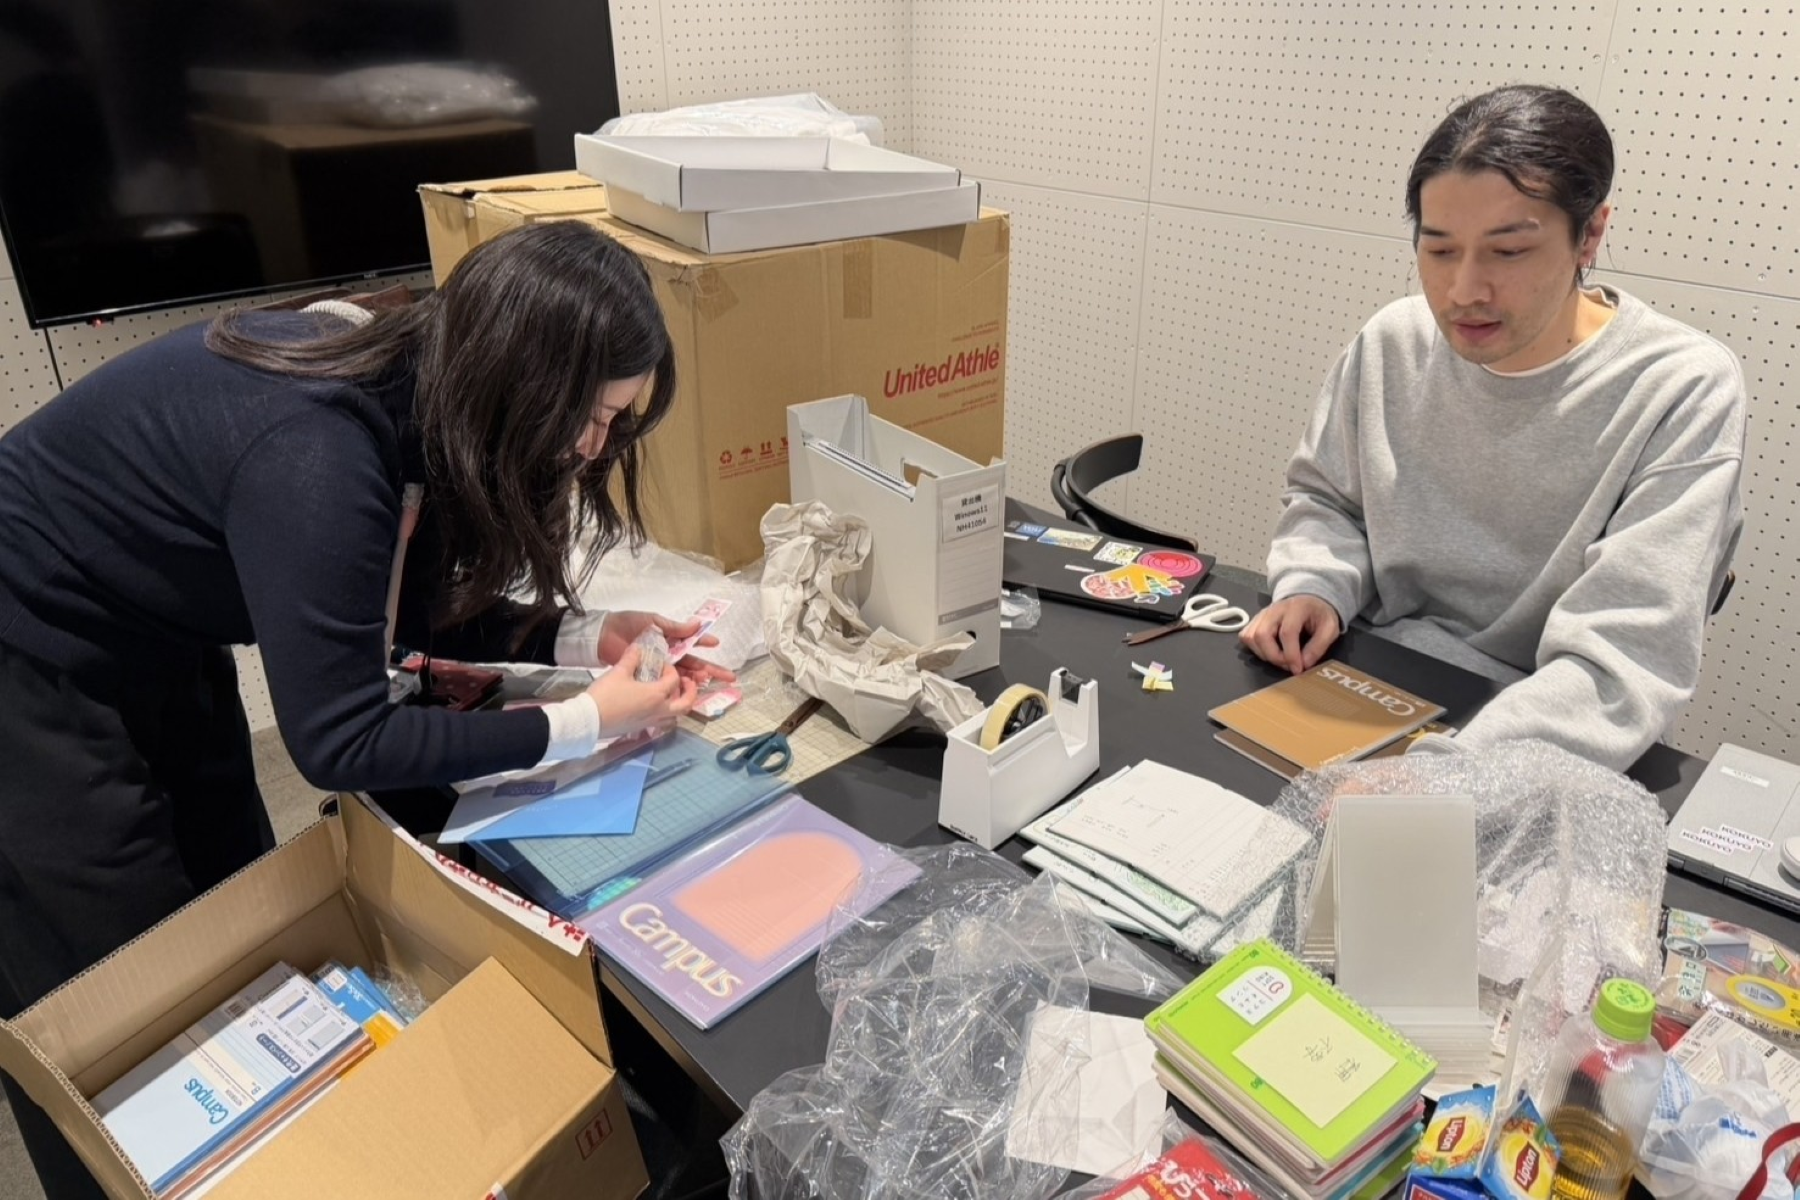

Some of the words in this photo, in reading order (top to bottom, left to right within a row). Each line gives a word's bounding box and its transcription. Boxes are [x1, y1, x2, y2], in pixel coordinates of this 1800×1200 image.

[883, 354, 952, 398] United
[951, 344, 1000, 380] Athle
[1316, 666, 1416, 717] Campus
[1682, 831, 1732, 853] KOKUYO
[1702, 828, 1752, 850] KOKUYO
[1721, 826, 1772, 848] KOKUYO
[618, 902, 745, 998] Campus
[183, 1077, 229, 1125] Campus
[1440, 1119, 1464, 1151] Lipton
[1515, 1148, 1538, 1187] Lipton
